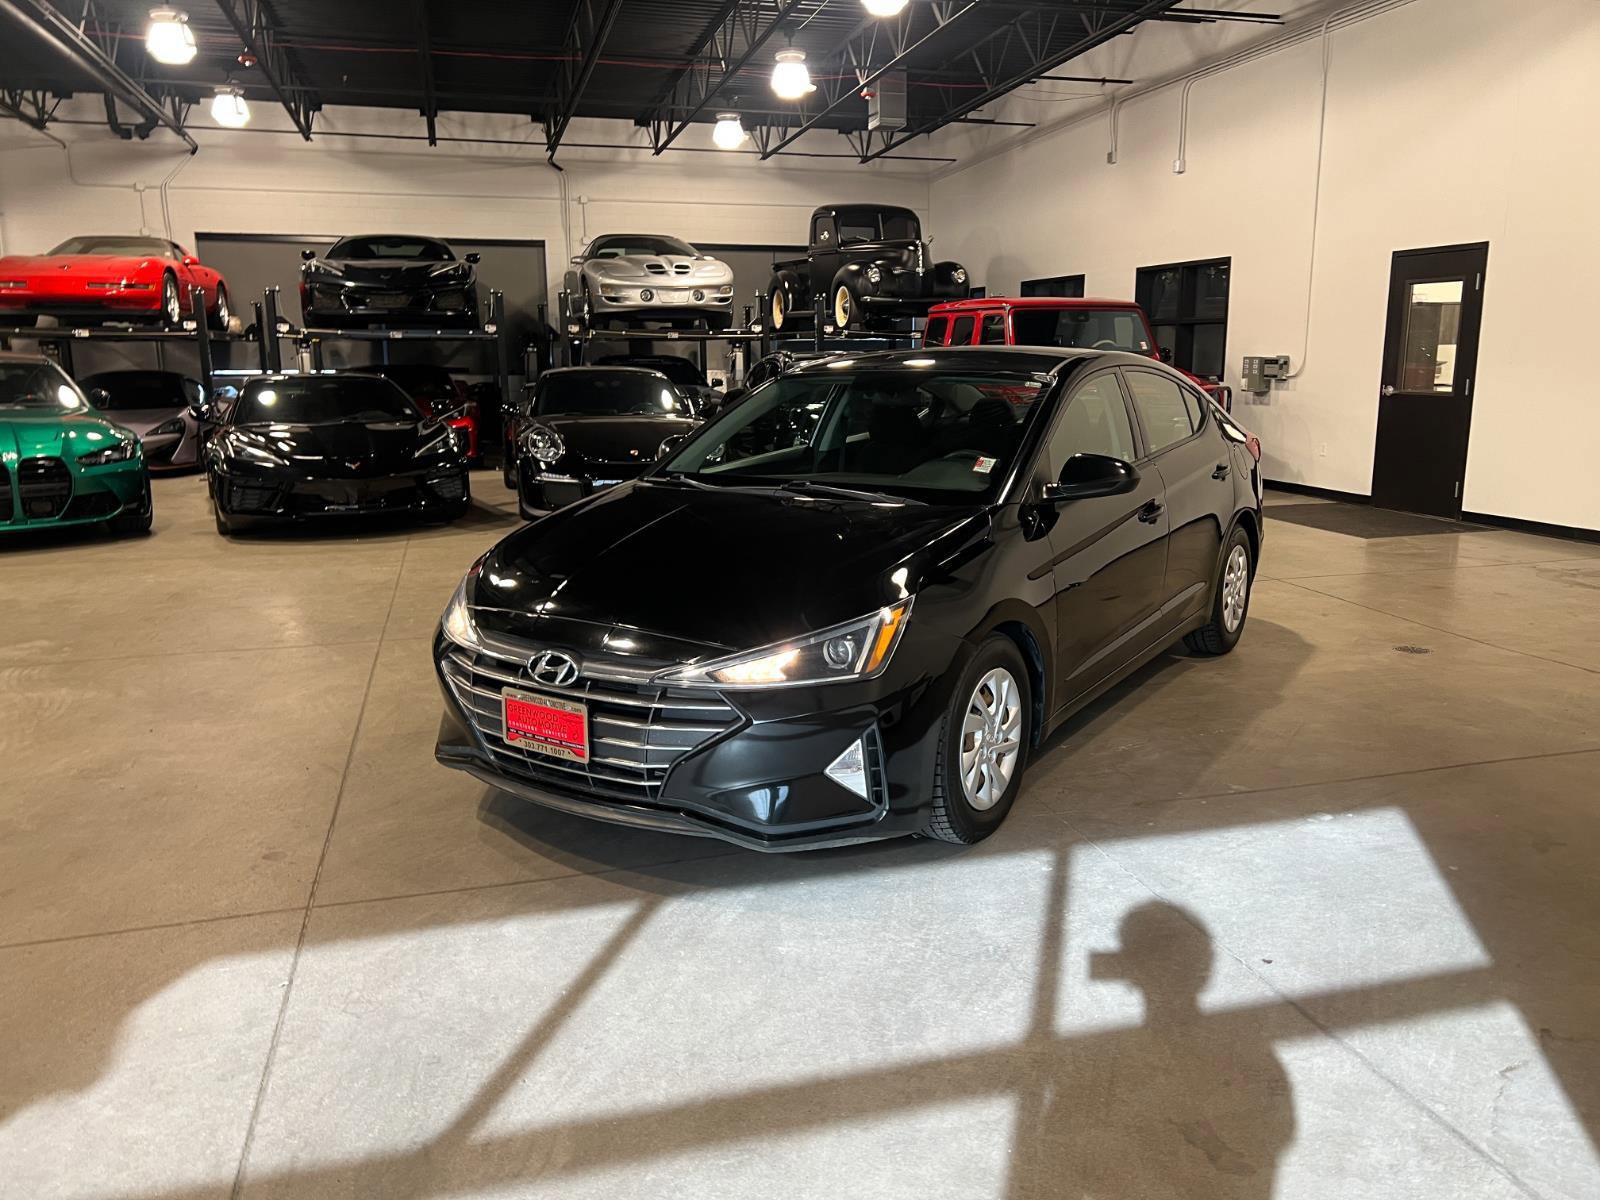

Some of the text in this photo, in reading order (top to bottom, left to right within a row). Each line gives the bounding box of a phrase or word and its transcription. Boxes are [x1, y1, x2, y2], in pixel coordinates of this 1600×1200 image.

[508, 703, 559, 721] GREENWOOD
[518, 714, 568, 732] AUTOMOTIVE
[524, 740, 566, 756] 303.771.1007
